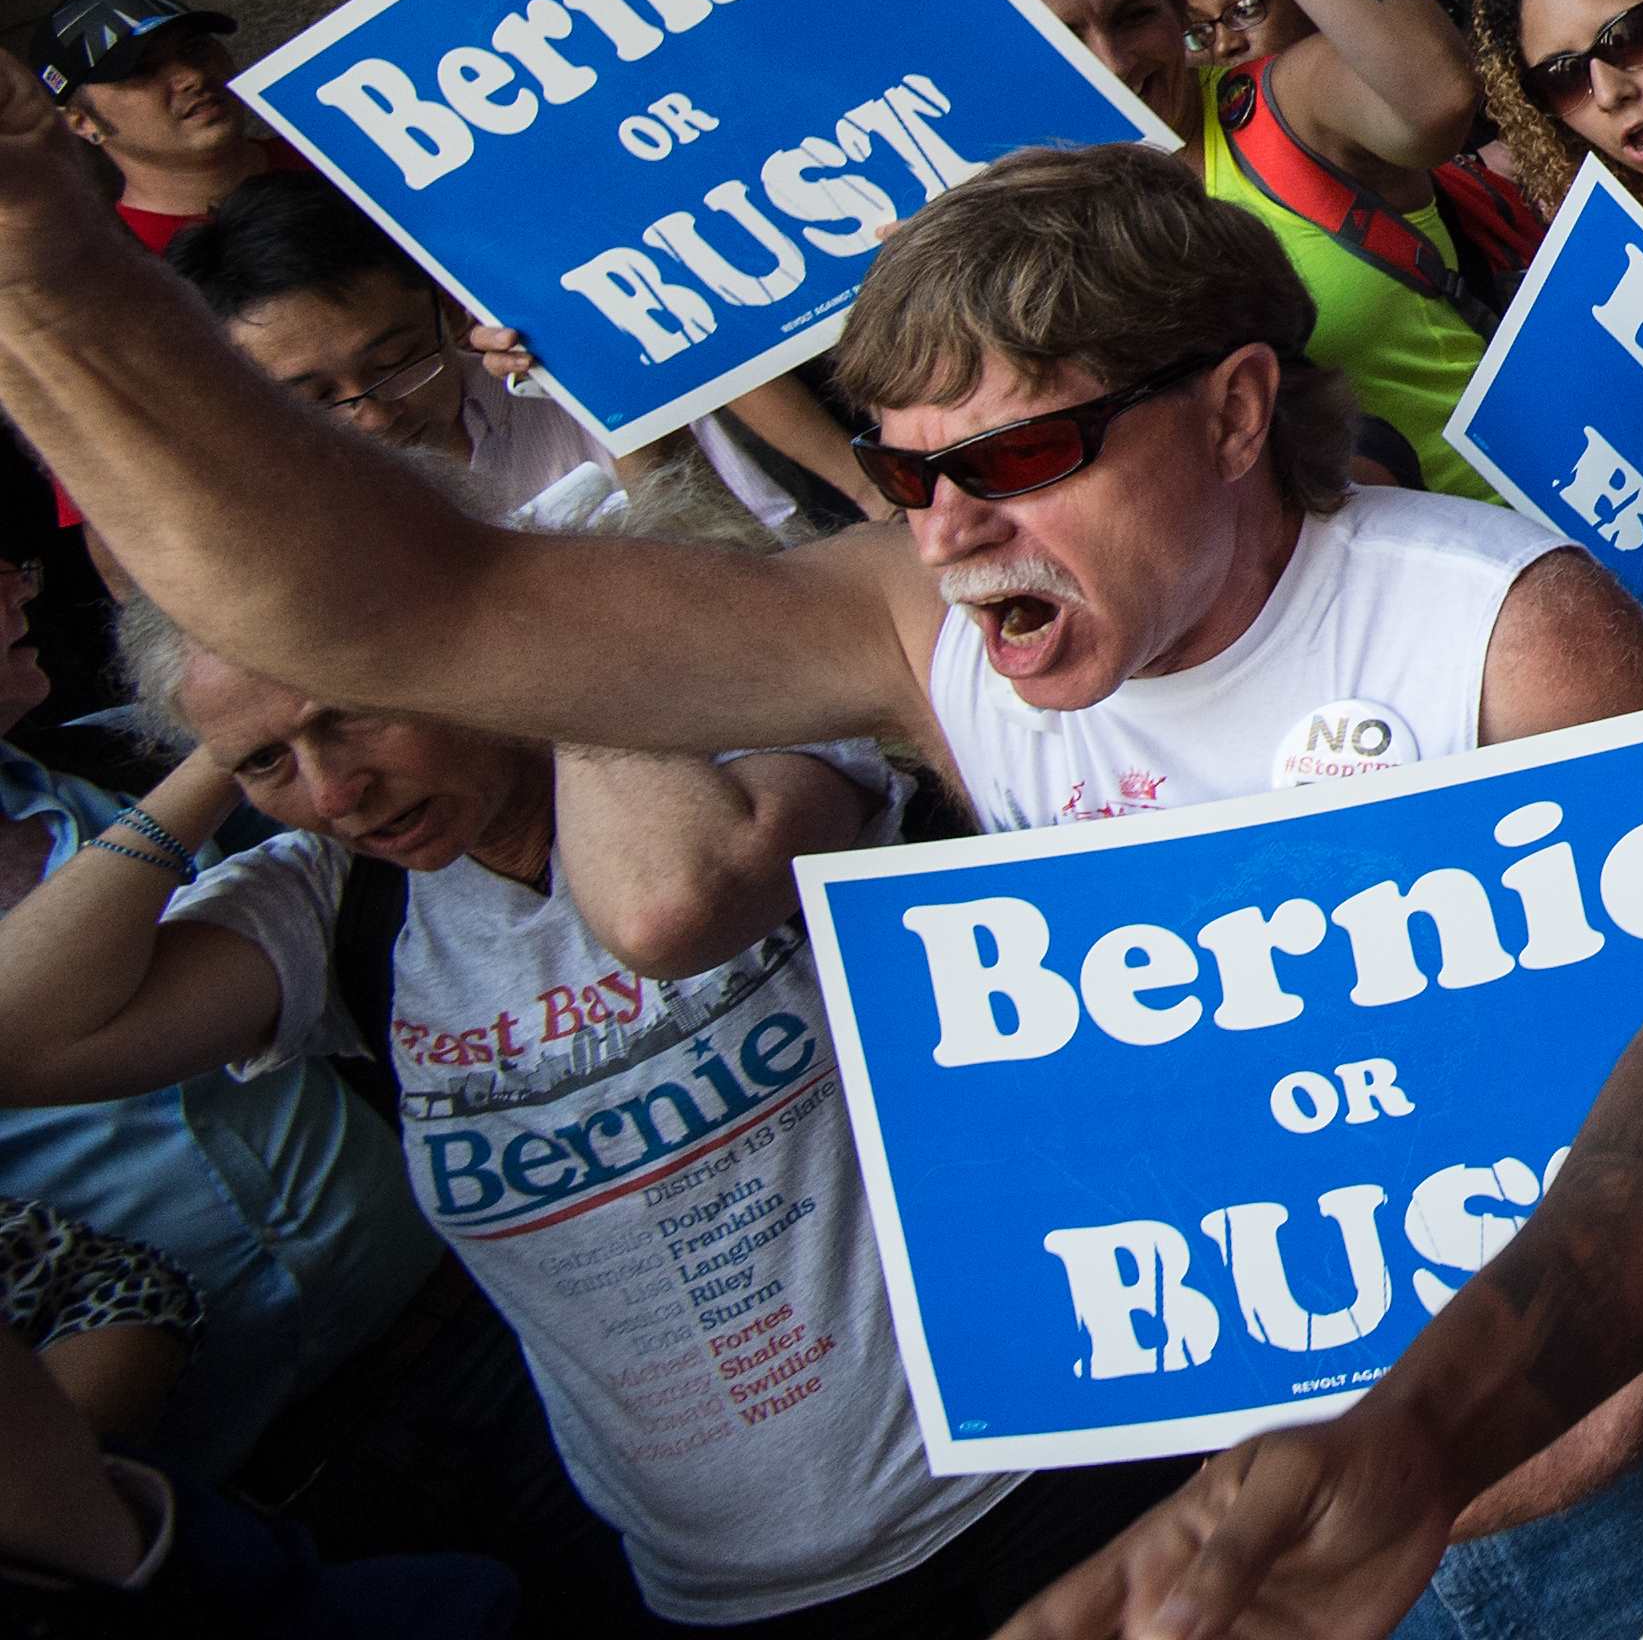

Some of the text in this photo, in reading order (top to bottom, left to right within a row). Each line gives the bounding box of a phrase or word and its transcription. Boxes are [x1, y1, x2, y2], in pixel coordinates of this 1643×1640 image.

[617, 91, 721, 163] OR
[560, 73, 991, 365] BUST
[1306, 714, 1393, 756] NO
[537, 970, 643, 1044] Bay
[423, 1011, 817, 1217] Bernie
[1270, 1057, 1415, 1135] OR
[643, 1078, 837, 1209] District 13 Slate
[658, 1174, 766, 1239] Dolphin
[668, 1190, 785, 1261] Franklin
[678, 1194, 817, 1284] Langlands
[688, 1264, 757, 1309] Riley
[1044, 1146, 1575, 1381] BUS
[699, 1277, 785, 1333] Sturm
[709, 1303, 795, 1358] Fortes
[719, 1323, 807, 1381] Shafer
[730, 1333, 837, 1405] Switlick
[1291, 1374, 1348, 1396] REVOLT
[740, 1375, 824, 1428] White
